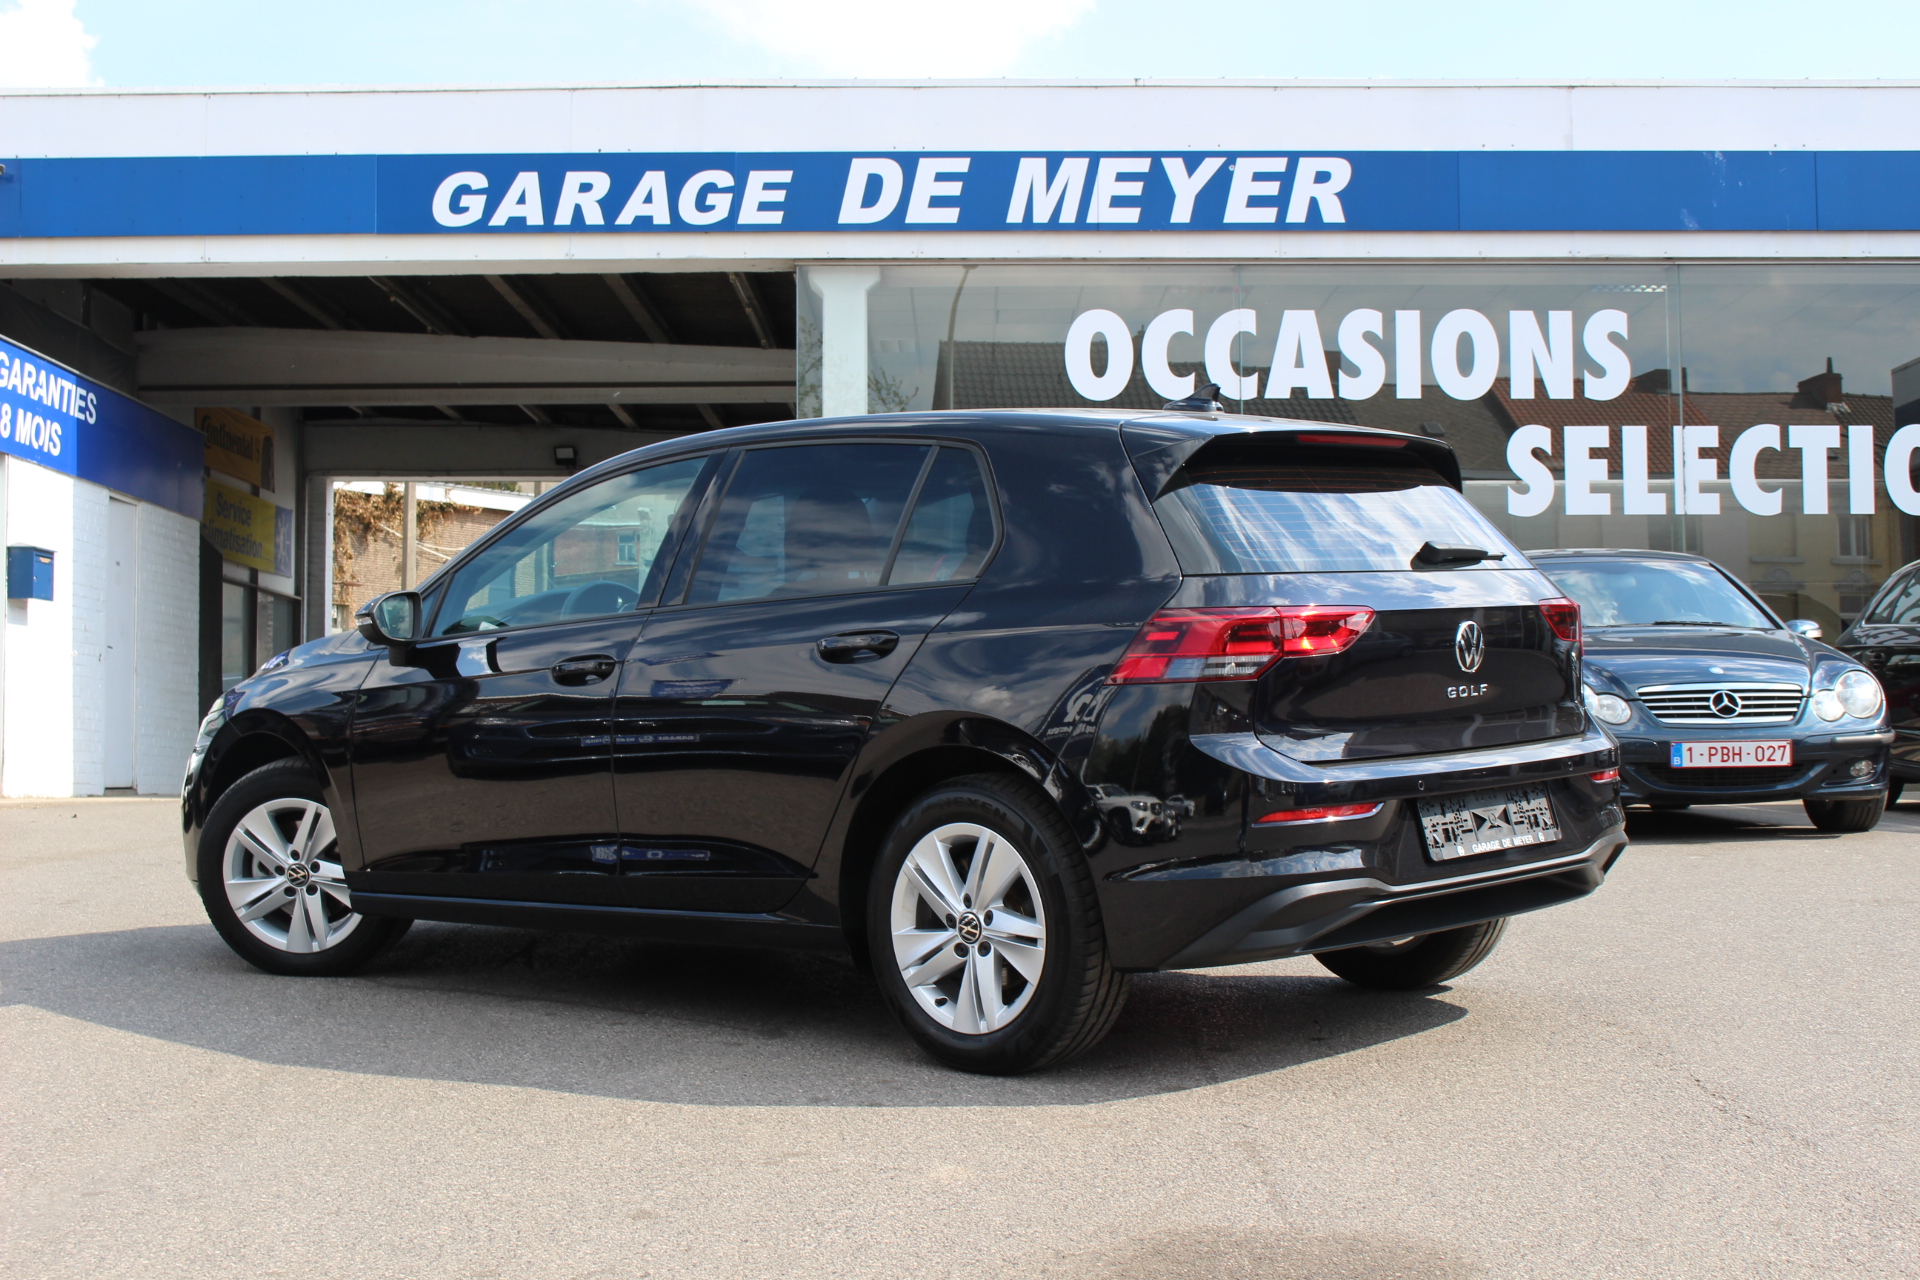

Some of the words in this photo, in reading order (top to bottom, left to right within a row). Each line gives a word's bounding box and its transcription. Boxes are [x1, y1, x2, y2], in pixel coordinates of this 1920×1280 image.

[432, 170, 794, 227] GARAGE
[837, 157, 971, 225] DE
[1005, 157, 1352, 224] MEYER
[1064, 308, 1632, 401] OCCASIONS
[15, 407, 62, 457] MOIS
[201, 415, 253, 460] Continental
[216, 491, 251, 527] Service
[1447, 683, 1488, 698] GOLF
[1674, 757, 1681, 765] B
[1472, 840, 1500, 853] GARAGE
[1502, 837, 1512, 847] DE
[1513, 834, 1534, 846] MEYER
